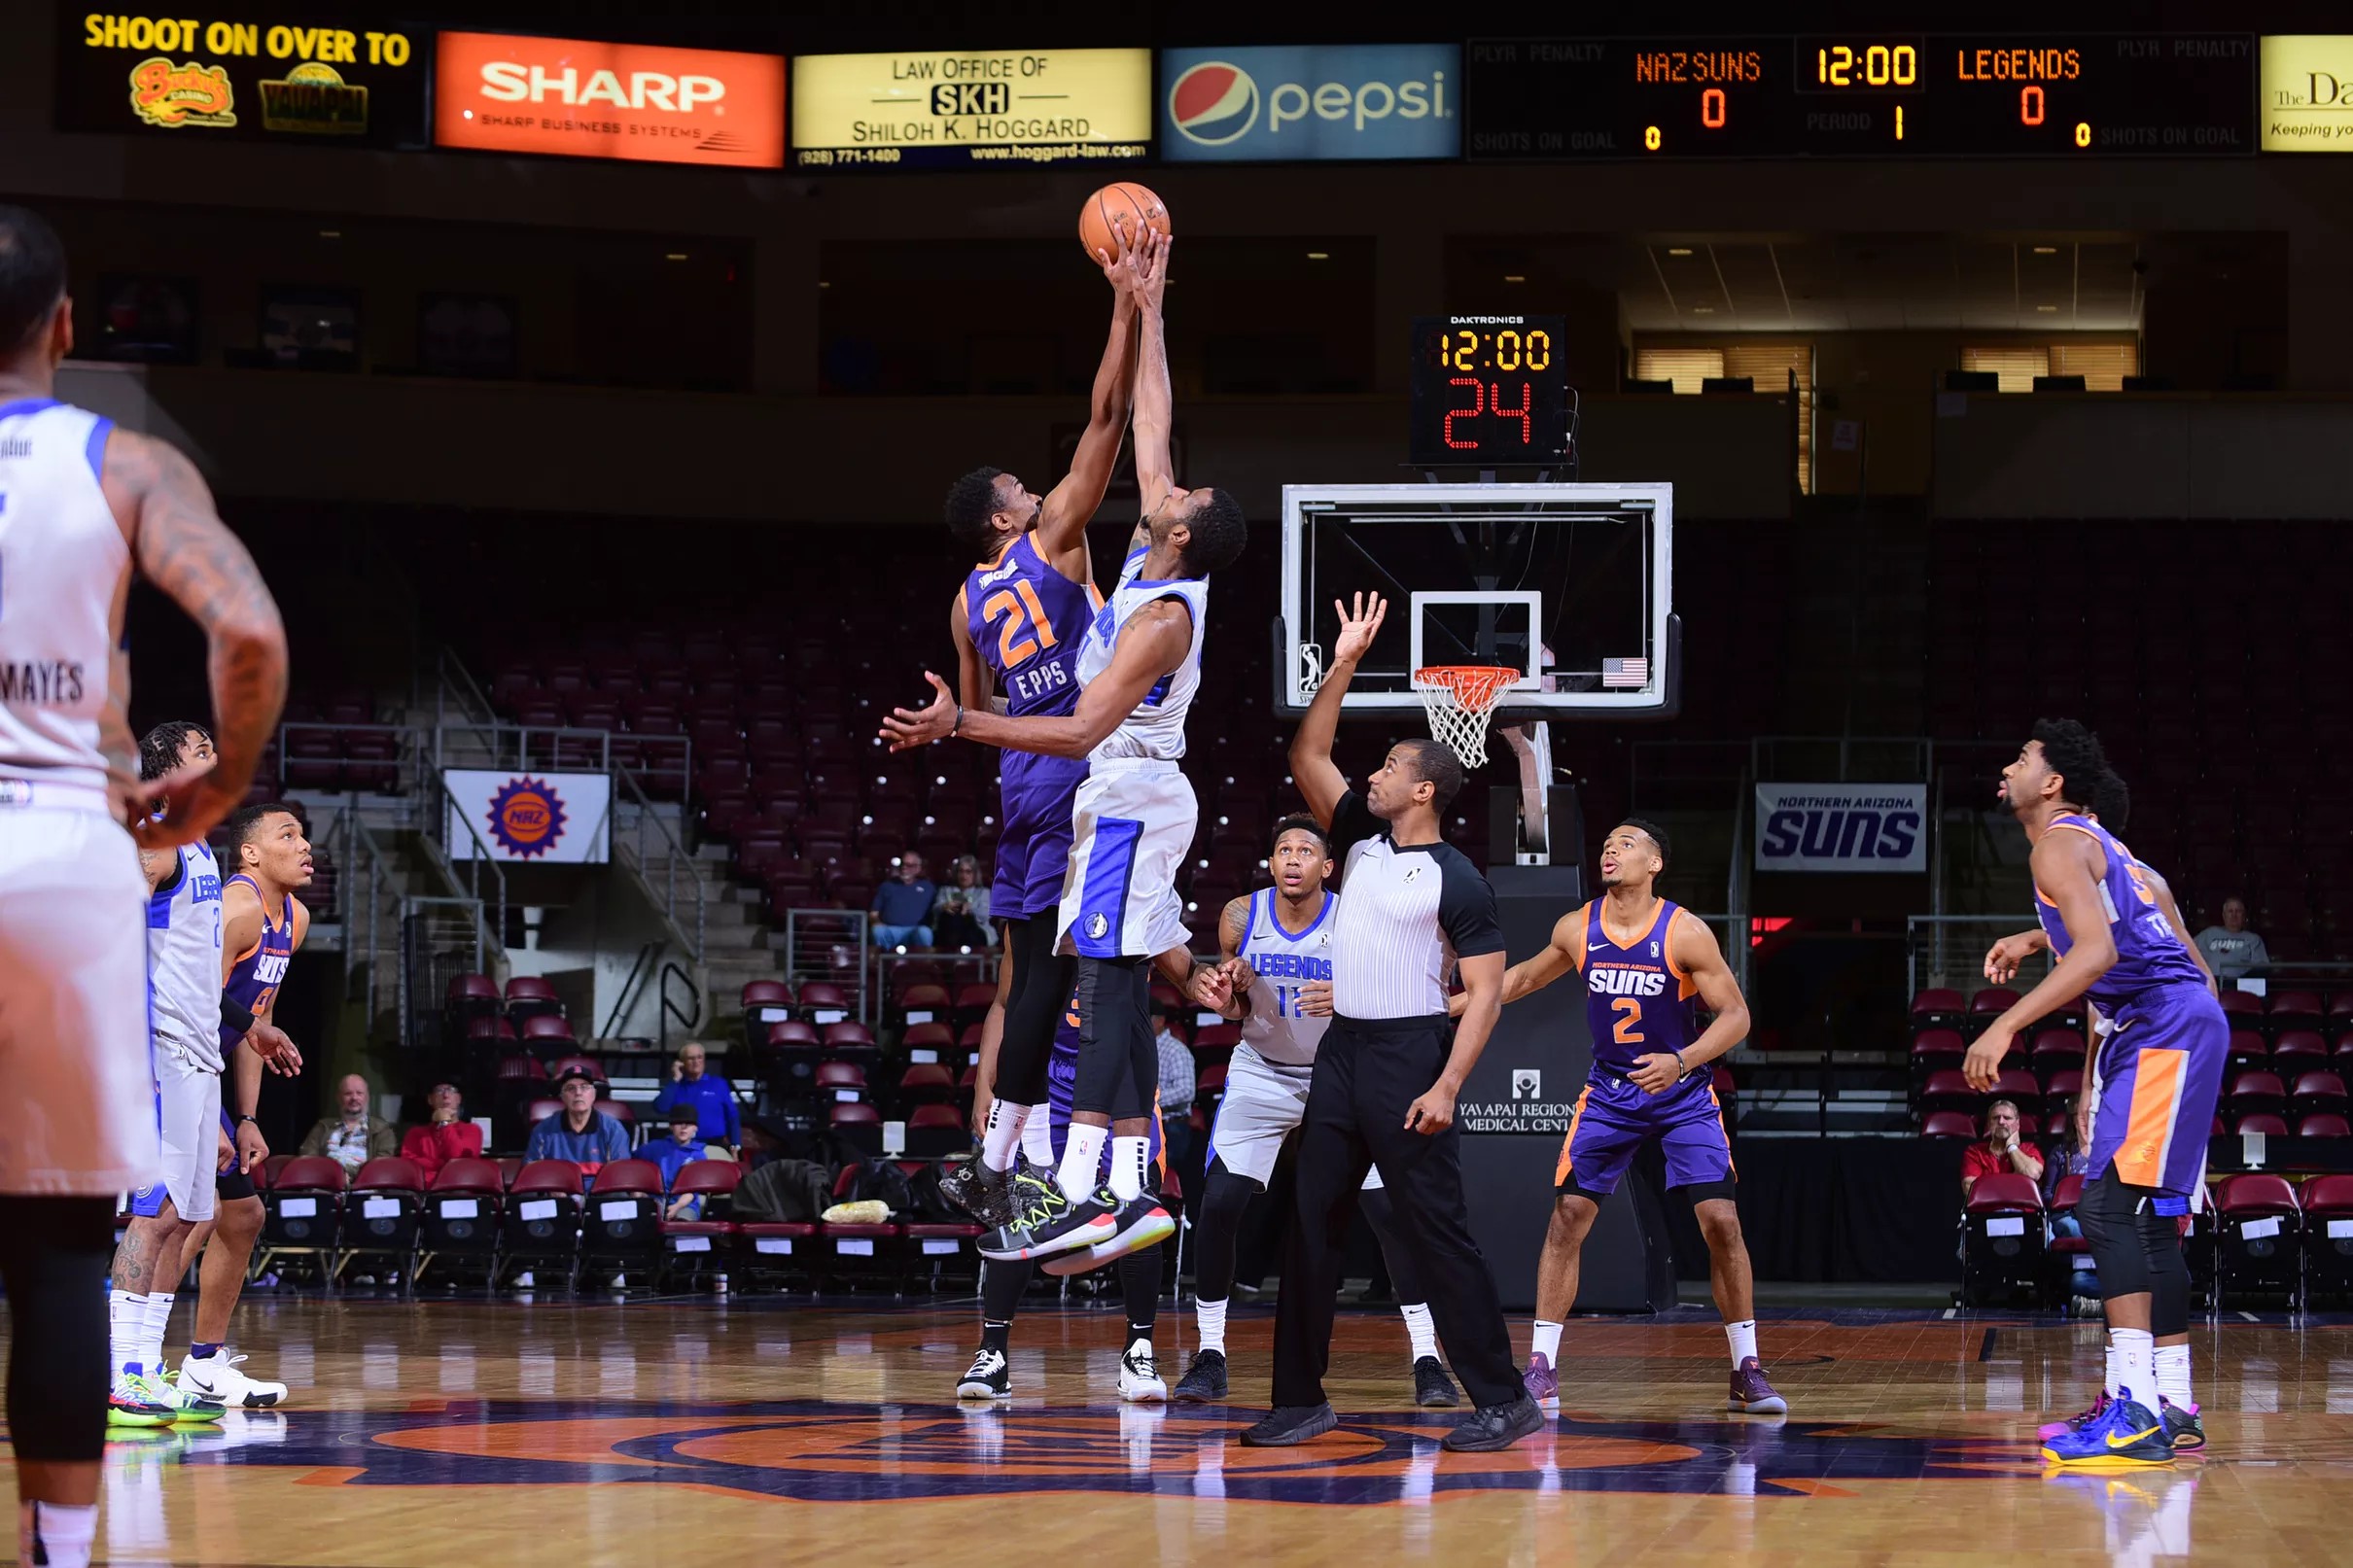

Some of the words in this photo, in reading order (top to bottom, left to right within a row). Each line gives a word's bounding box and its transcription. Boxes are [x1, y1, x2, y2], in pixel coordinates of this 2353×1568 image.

[85, 14, 199, 52] SHOOT
[205, 22, 258, 56] ON
[265, 25, 357, 63] OVER
[365, 31, 410, 67] TO
[893, 59, 936, 80] LAW
[942, 57, 1013, 79] OFFICE
[1818, 46, 1915, 86] 12:00
[1958, 50, 2080, 81] LEGENDS
[480, 61, 725, 113] SHARP
[935, 85, 1006, 116] SKH
[1269, 70, 1445, 132] pepsi
[2274, 89, 2304, 105] The
[2305, 71, 2353, 106] Da
[1703, 88, 1725, 127] 0
[2021, 86, 2044, 125] 0
[481, 114, 535, 128] SHARP
[542, 118, 621, 134] BUSINESS
[630, 123, 702, 139] SYSTEMS
[853, 120, 934, 142] SHILOH
[943, 119, 966, 141] K.
[976, 117, 1091, 140] HOGGARD
[1895, 105, 1904, 141] 1
[2270, 122, 2332, 138] Keeping
[2335, 125, 2353, 139] yo
[970, 143, 1145, 161] www.hoggard-law.com
[1450, 316, 1525, 325] DAKTRONICS
[1442, 331, 1550, 371] 12:00
[1444, 377, 1530, 449] 24
[983, 577, 1060, 670] 21
[1014, 660, 1068, 701] EPPS
[1776, 796, 1852, 809] NORTHERN
[1853, 796, 1914, 809] ARIZONA
[1761, 810, 1920, 859] SUNS
[1249, 953, 1333, 981] LEGENDS
[1588, 968, 1667, 996] SUNS
[1276, 985, 1303, 1019] 11
[1610, 997, 1645, 1044] 2
[1464, 1118, 1529, 1132] MEDICAL
[1531, 1118, 1568, 1132] CENT
[1522, 1103, 1576, 1117] REGION
